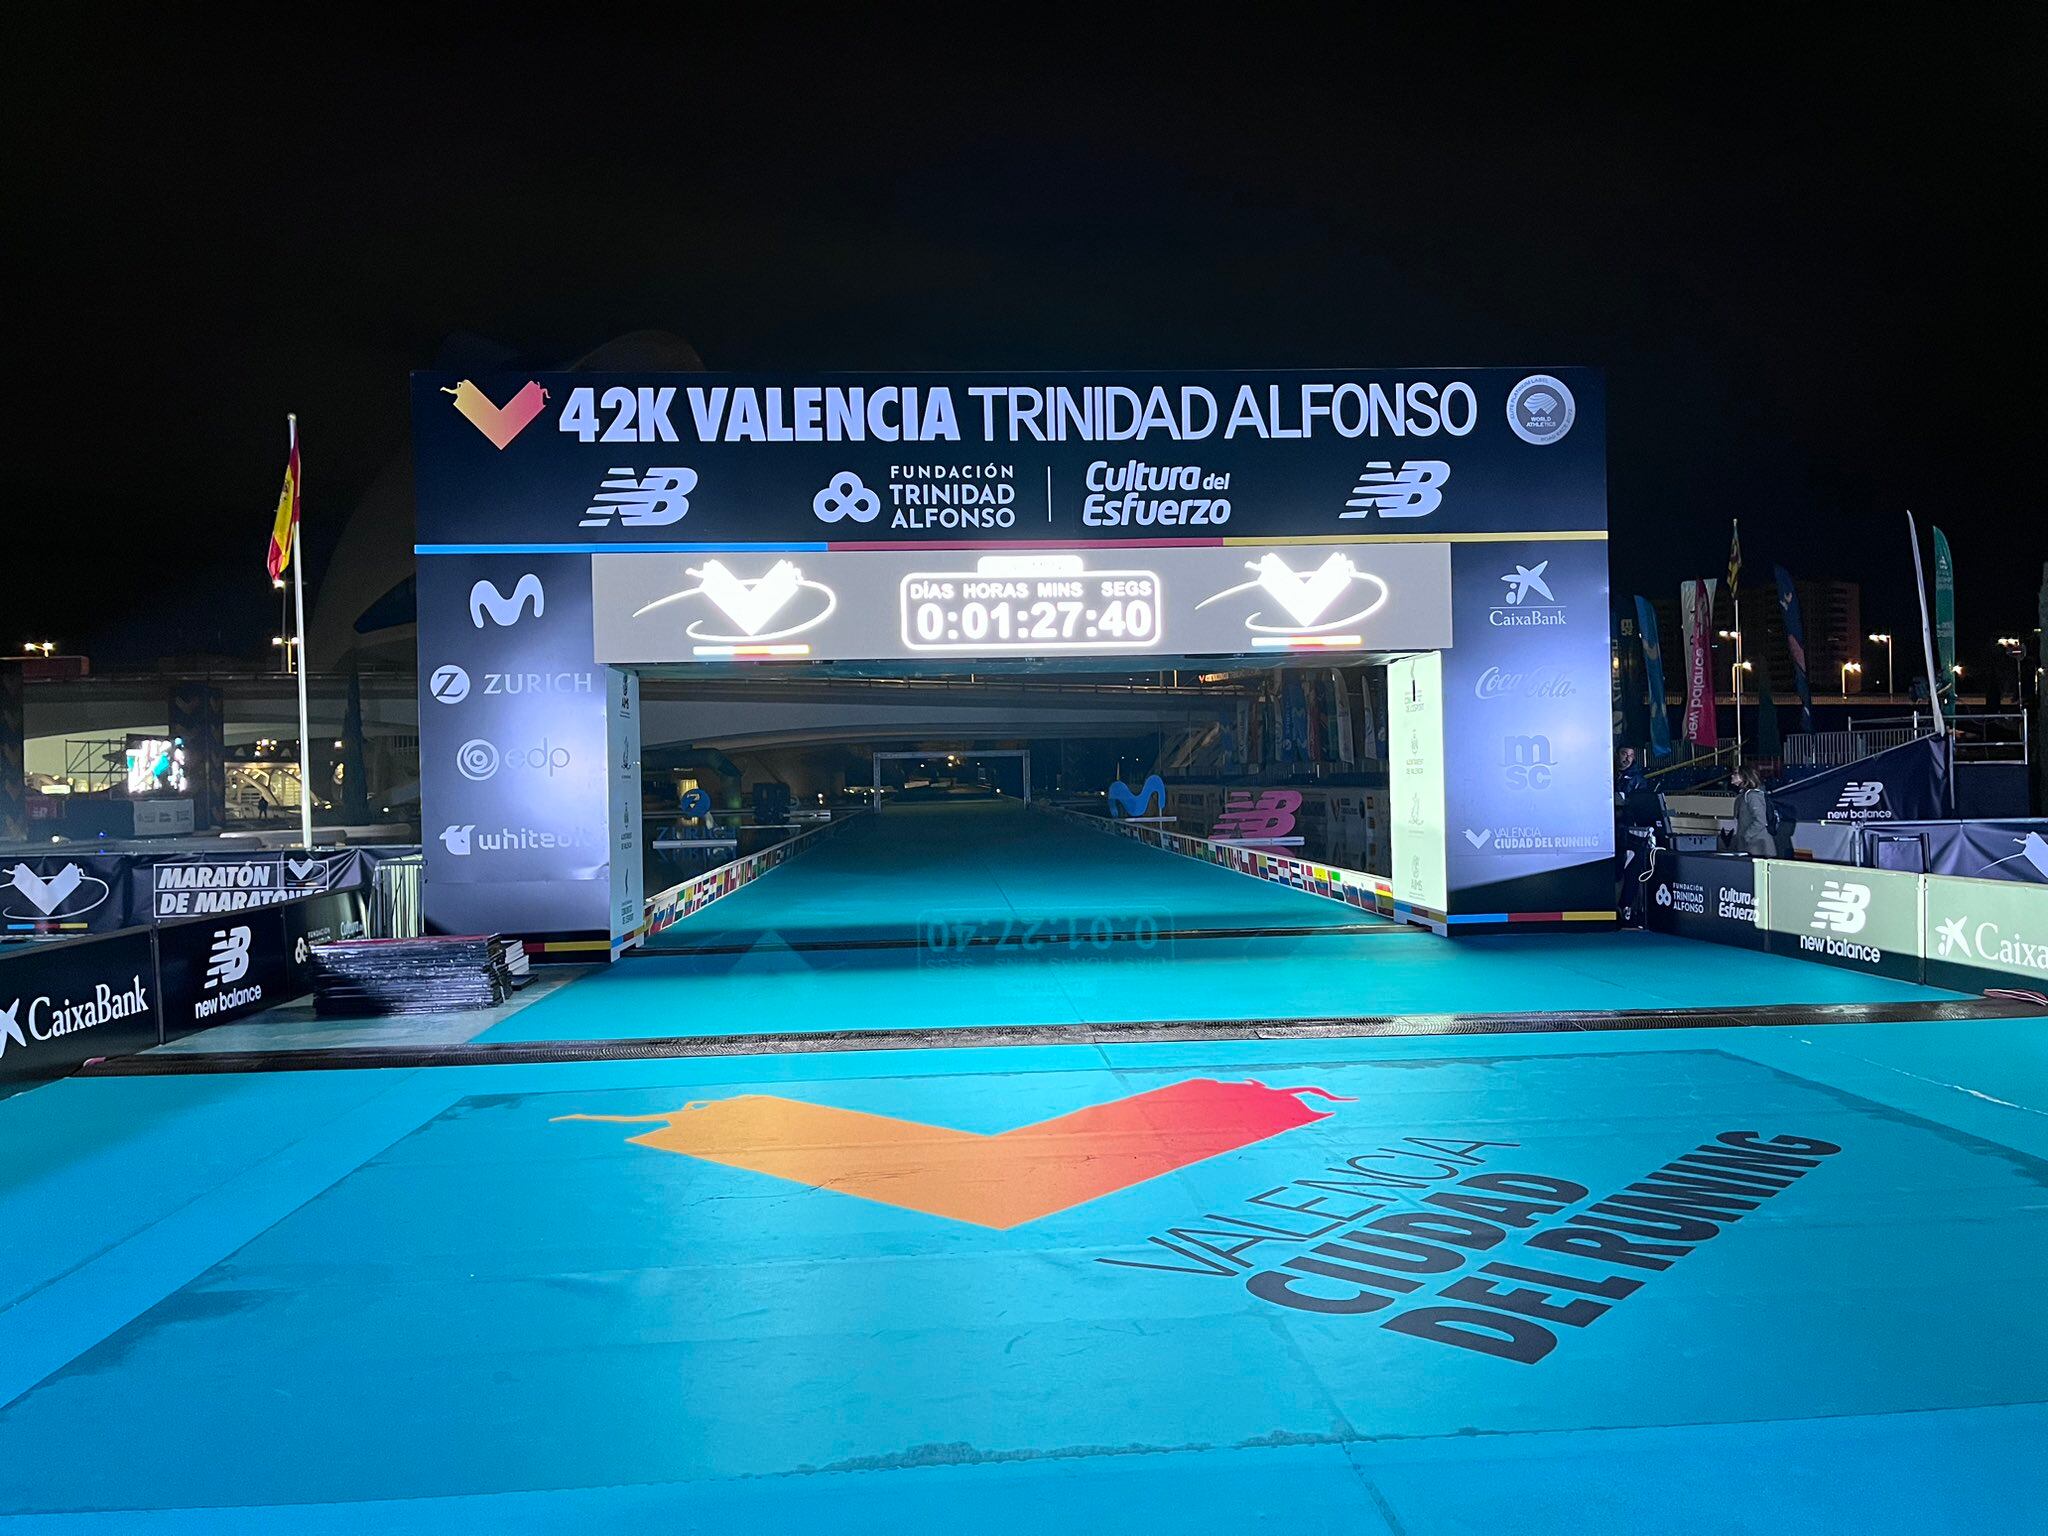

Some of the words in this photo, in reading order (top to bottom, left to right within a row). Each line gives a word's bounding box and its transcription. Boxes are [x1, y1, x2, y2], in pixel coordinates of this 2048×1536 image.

[558, 386, 679, 442] 42K
[686, 386, 961, 443] VALENCIA
[968, 385, 1218, 442] TRINIDAD
[1224, 381, 1478, 440] ALFONSO
[890, 462, 1014, 479] FUNDACIÓN
[1086, 459, 1201, 492] Cultura
[1203, 473, 1231, 490] del
[889, 483, 1015, 505] TRINIDAD
[890, 507, 1016, 529] ALFONSO
[1082, 492, 1232, 527] Esfuerzo
[910, 580, 955, 599] DÍAS
[963, 582, 1029, 599] HORAS
[1037, 581, 1084, 598] MINS
[1101, 580, 1152, 598] SEGS
[916, 599, 1152, 640] 0:01:27:40
[1489, 610, 1567, 627] CaixaBank
[483, 672, 593, 695] ZURICH
[504, 737, 571, 778] edp
[1827, 810, 1849, 819] new
[1850, 809, 1892, 819] balance
[1494, 827, 1542, 838] VALENCIA
[1494, 837, 1533, 850] CIUDAD
[1535, 837, 1554, 849] DEL
[158, 861, 271, 889] MARATÓN
[160, 891, 190, 914] DE
[194, 889, 325, 913] MARATO
[1673, 890, 1704, 903] TRINIDAD
[1673, 901, 1704, 914] ALFONSO
[1719, 886, 1752, 906] Cultura
[1718, 901, 1760, 922] Esfuerzo
[1800, 934, 1824, 953] new
[1826, 935, 1881, 963] balance
[28, 974, 149, 1041] CaixaBank
[194, 997, 218, 1019] new
[219, 984, 262, 1012] balance
[1092, 1135, 1521, 1278] VALENCIA
[1245, 1172, 1589, 1315] CIUDAD
[1380, 1260, 1649, 1365] DEL
